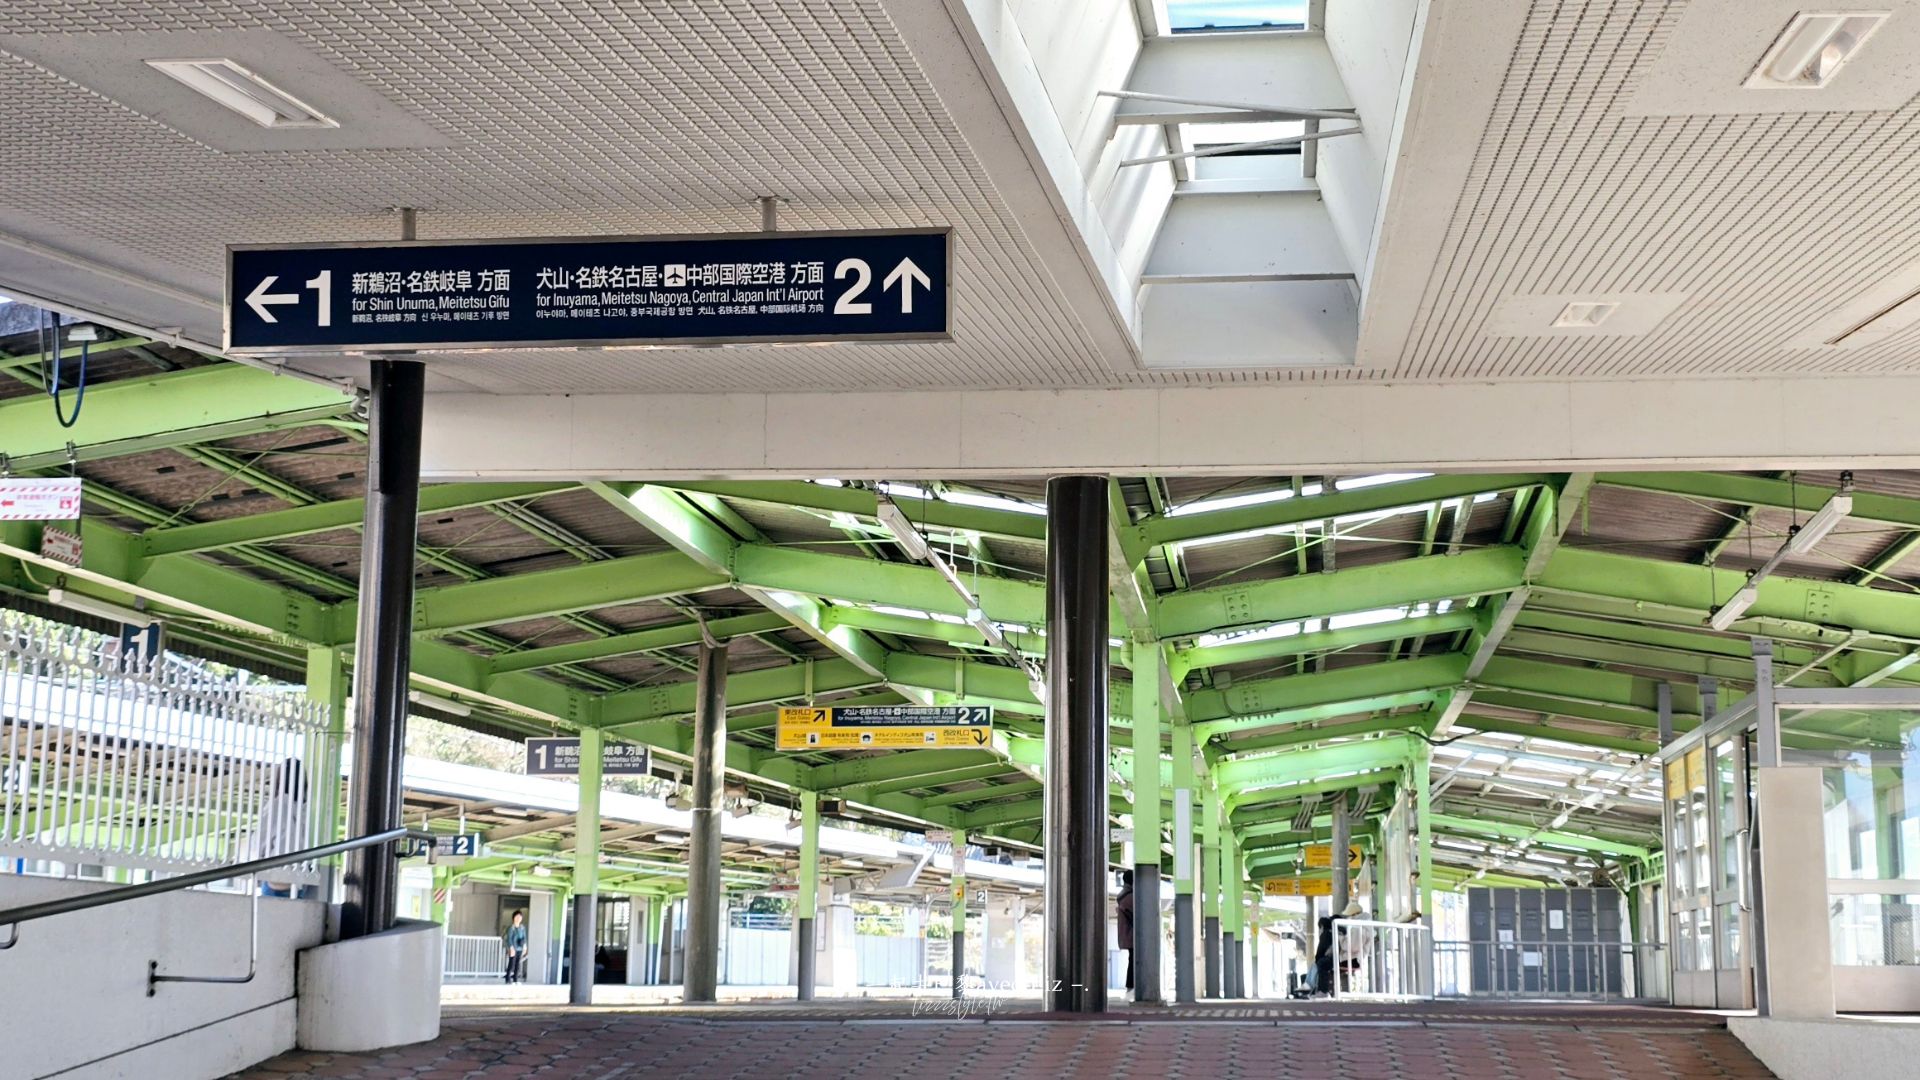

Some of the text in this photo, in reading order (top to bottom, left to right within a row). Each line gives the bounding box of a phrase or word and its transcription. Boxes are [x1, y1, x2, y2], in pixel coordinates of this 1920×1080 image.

[477, 269, 511, 292] 方面
[686, 262, 786, 287] 中部国際空港
[790, 261, 825, 285] 方面
[535, 293, 551, 307] for
[601, 291, 647, 306] Meitetsu
[692, 289, 730, 304] Central
[731, 288, 764, 305] Japan
[787, 287, 824, 304] Airport
[833, 257, 872, 315] 2
[305, 270, 331, 327] 1
[351, 297, 367, 312] for
[369, 296, 394, 312] Shin
[438, 295, 487, 310] Meitetsu
[488, 294, 510, 309] Gifu
[130, 629, 149, 663] 1
[957, 707, 971, 724] 2
[534, 744, 547, 770] 1
[456, 836, 469, 854] 2
[977, 891, 986, 903] 2
